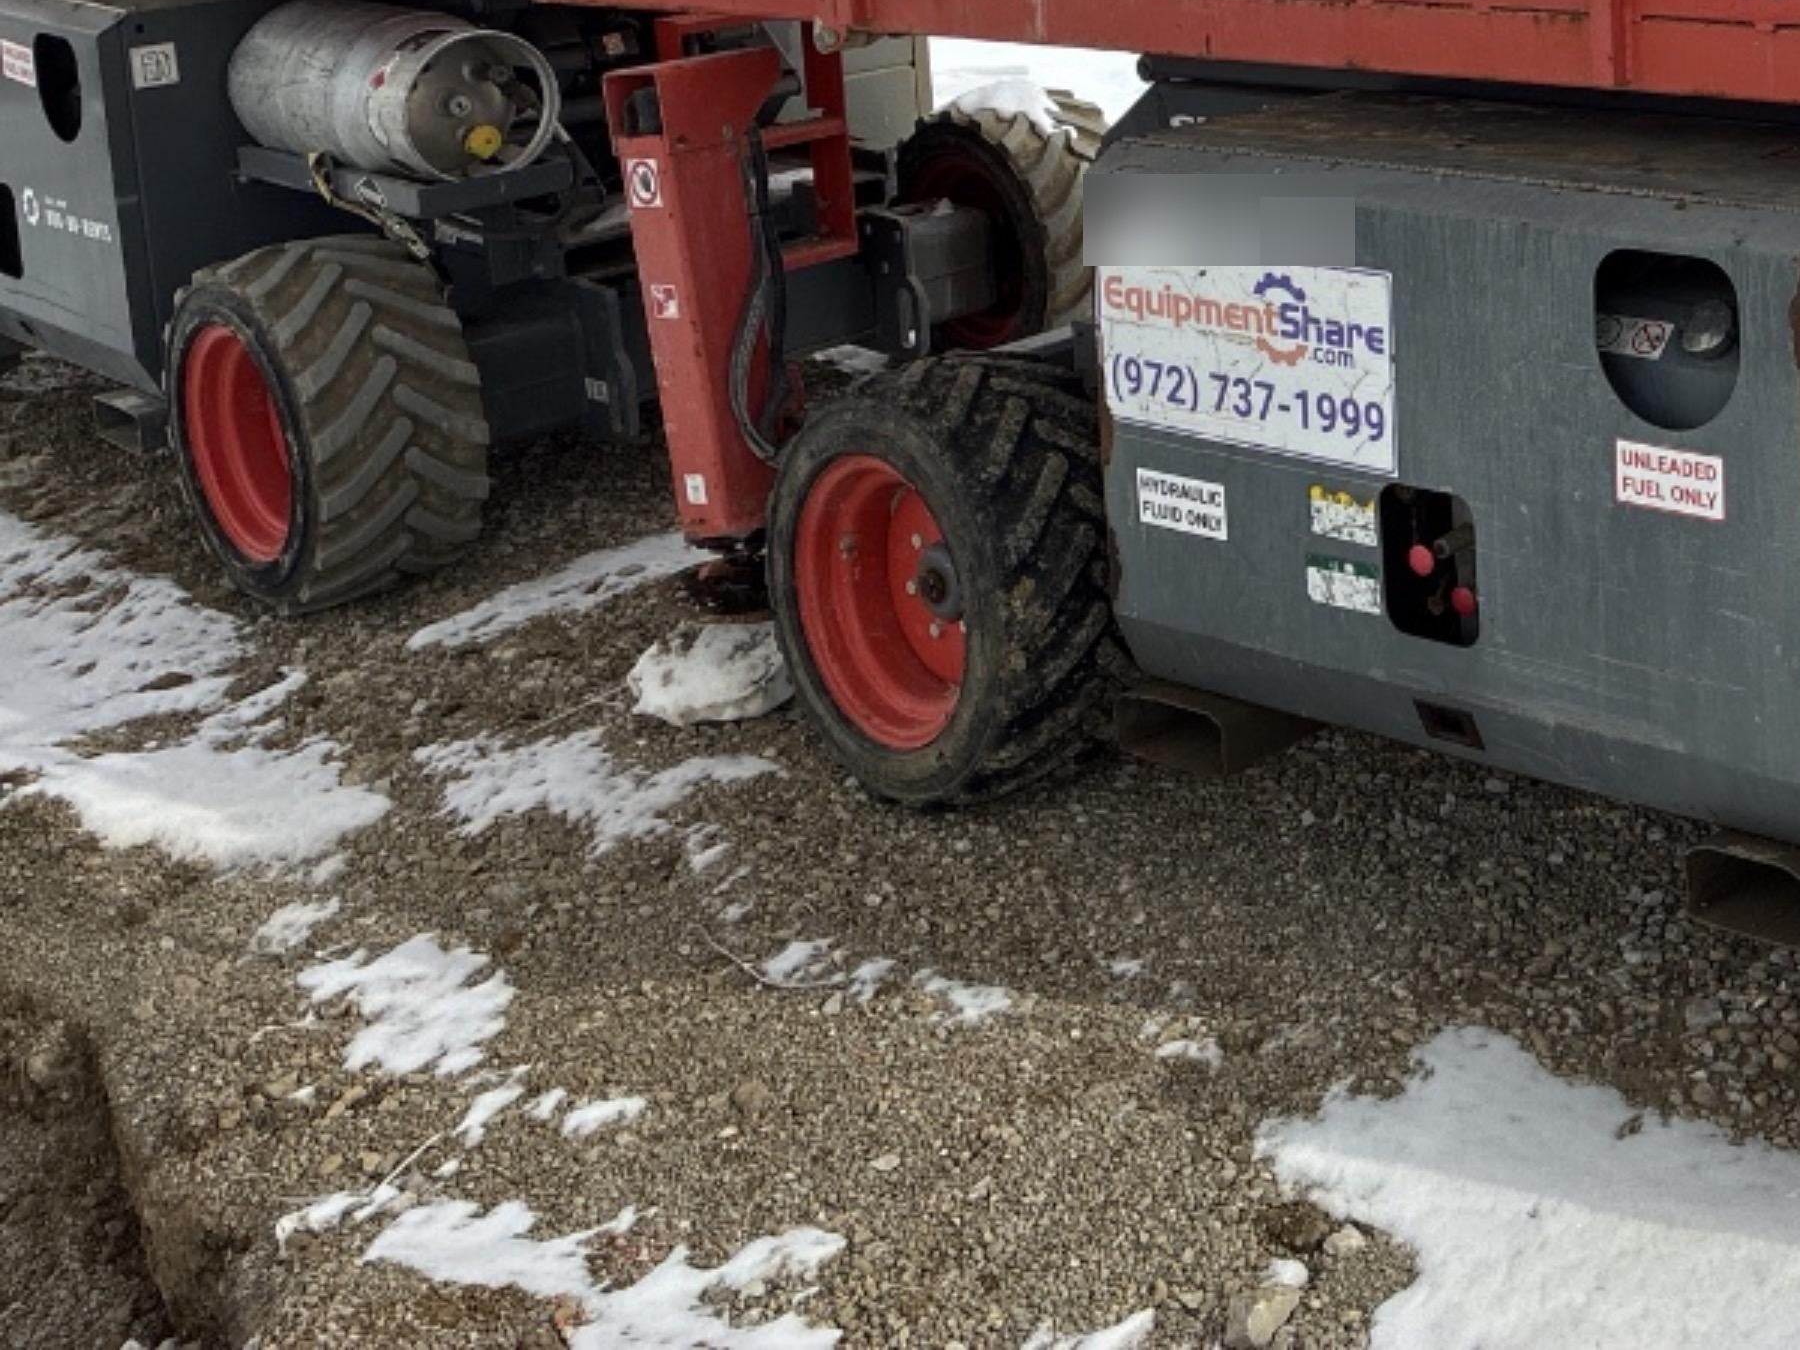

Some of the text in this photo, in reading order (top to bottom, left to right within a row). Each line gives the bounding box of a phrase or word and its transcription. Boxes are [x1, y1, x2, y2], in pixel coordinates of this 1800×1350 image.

[1103, 275, 1385, 354] EquipmentShare
[1112, 353, 1385, 442] (972) 737-1999
[1621, 449, 1717, 482] UNLEADED
[1622, 476, 1718, 511] FUEL ONLY
